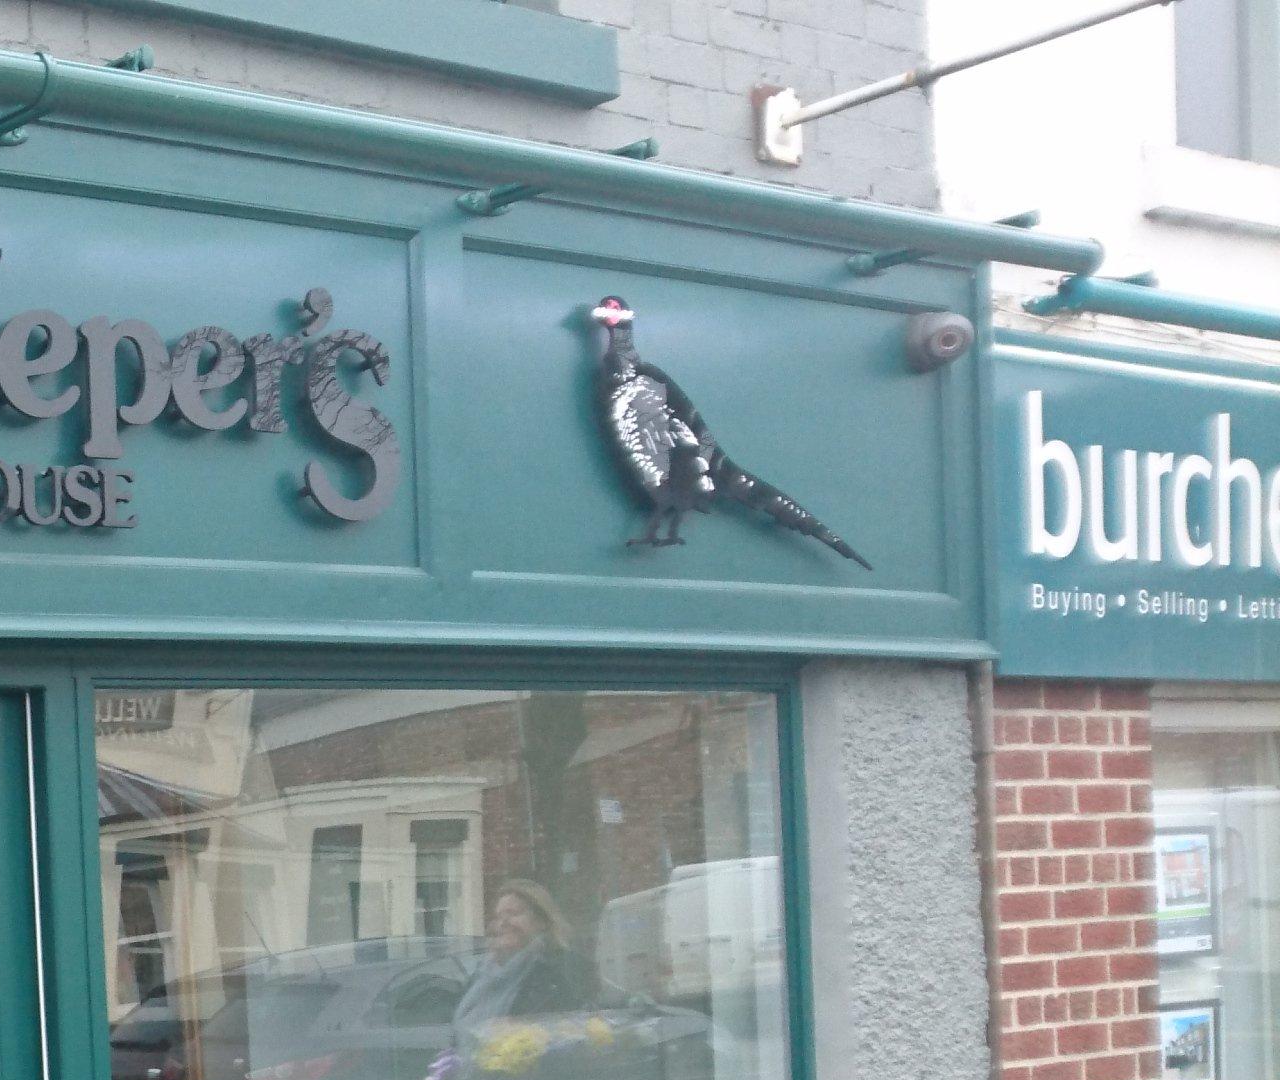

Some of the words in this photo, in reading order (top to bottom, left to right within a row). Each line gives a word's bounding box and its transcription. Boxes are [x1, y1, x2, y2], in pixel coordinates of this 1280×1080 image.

[1028, 390, 1280, 575] burch
[1032, 583, 1106, 618] Buying
[1137, 589, 1209, 622] Selling
